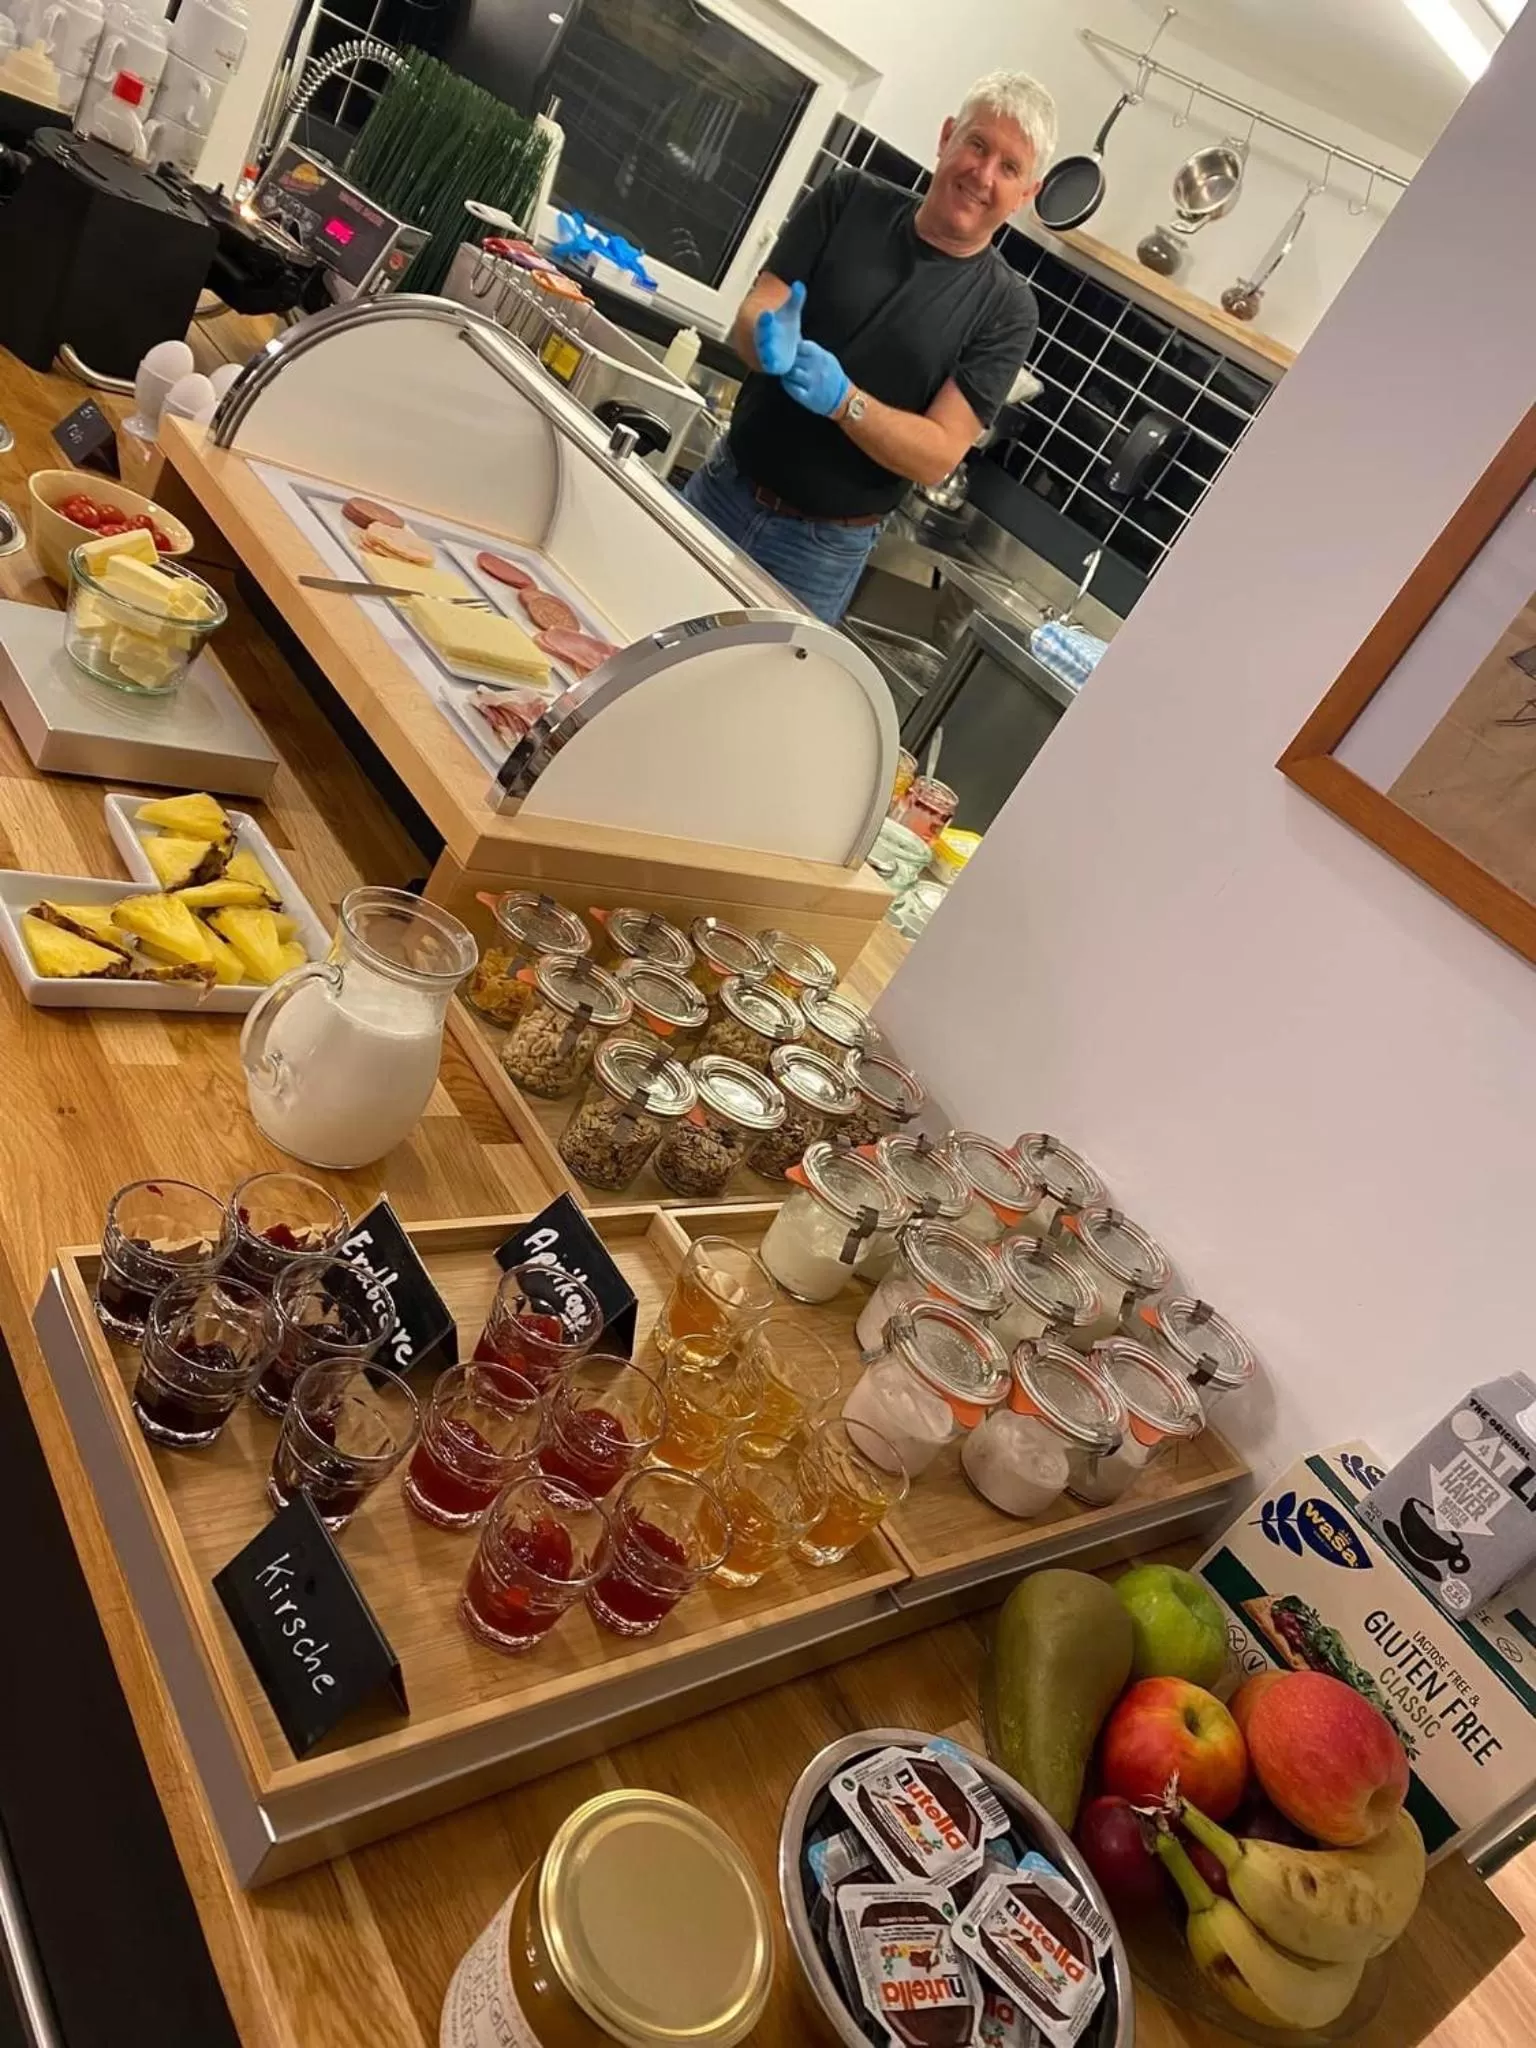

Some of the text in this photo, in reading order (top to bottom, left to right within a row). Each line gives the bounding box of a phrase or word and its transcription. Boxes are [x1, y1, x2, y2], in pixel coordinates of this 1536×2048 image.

[1469, 1397, 1531, 1461] THE ORIGINAL
[1439, 1471, 1488, 1521] HAVER
[1452, 1459, 1500, 1508] HAFER
[1304, 1501, 1358, 1567] wasa
[255, 1552, 336, 1696] Kirsche
[1363, 1610, 1503, 1767] GLUTEN FREE
[1379, 1666, 1442, 1740] CLASSIC
[1412, 1630, 1481, 1708] LACTOSE FREE &
[894, 1766, 966, 1851] nutella
[1004, 1897, 1085, 1984] nutella
[879, 1974, 967, 2011] nutella
